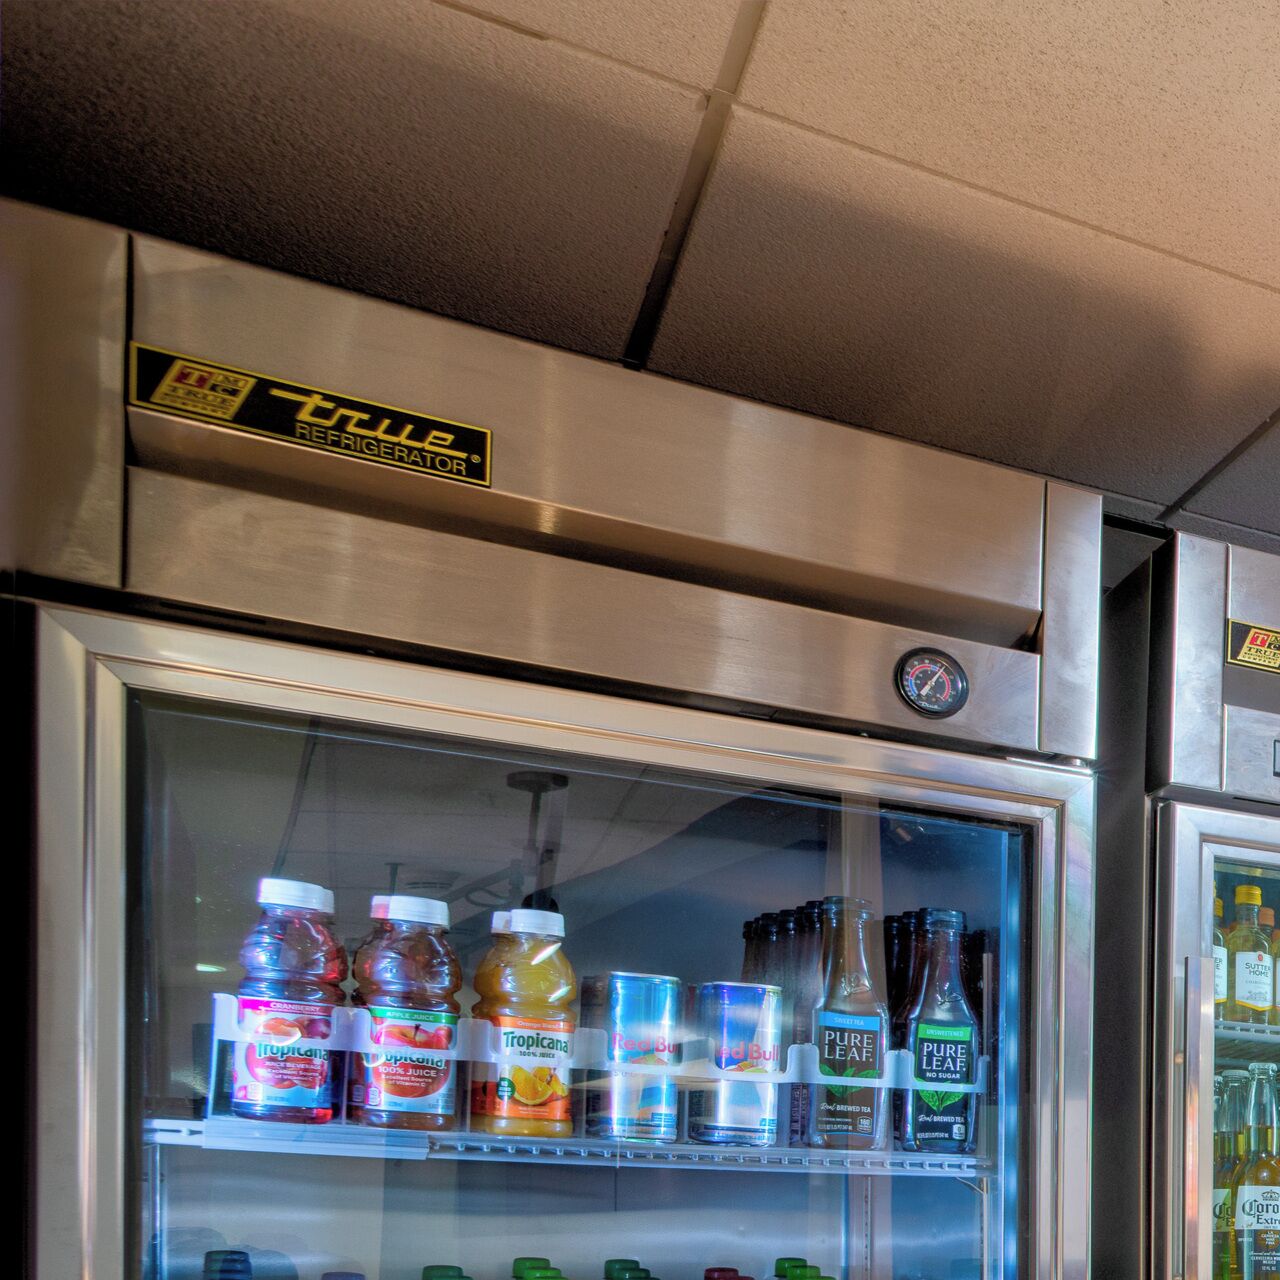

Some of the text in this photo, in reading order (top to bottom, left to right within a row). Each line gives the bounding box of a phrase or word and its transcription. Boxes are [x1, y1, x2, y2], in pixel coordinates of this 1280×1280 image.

[295, 423, 467, 476] REFRIGERATOR
[411, 1014, 435, 1022] JUICE
[503, 1031, 569, 1053] Tropicana
[825, 1031, 873, 1047] PURE
[923, 1043, 967, 1058] PURE
[378, 1066, 438, 1078] 100% JUICE
